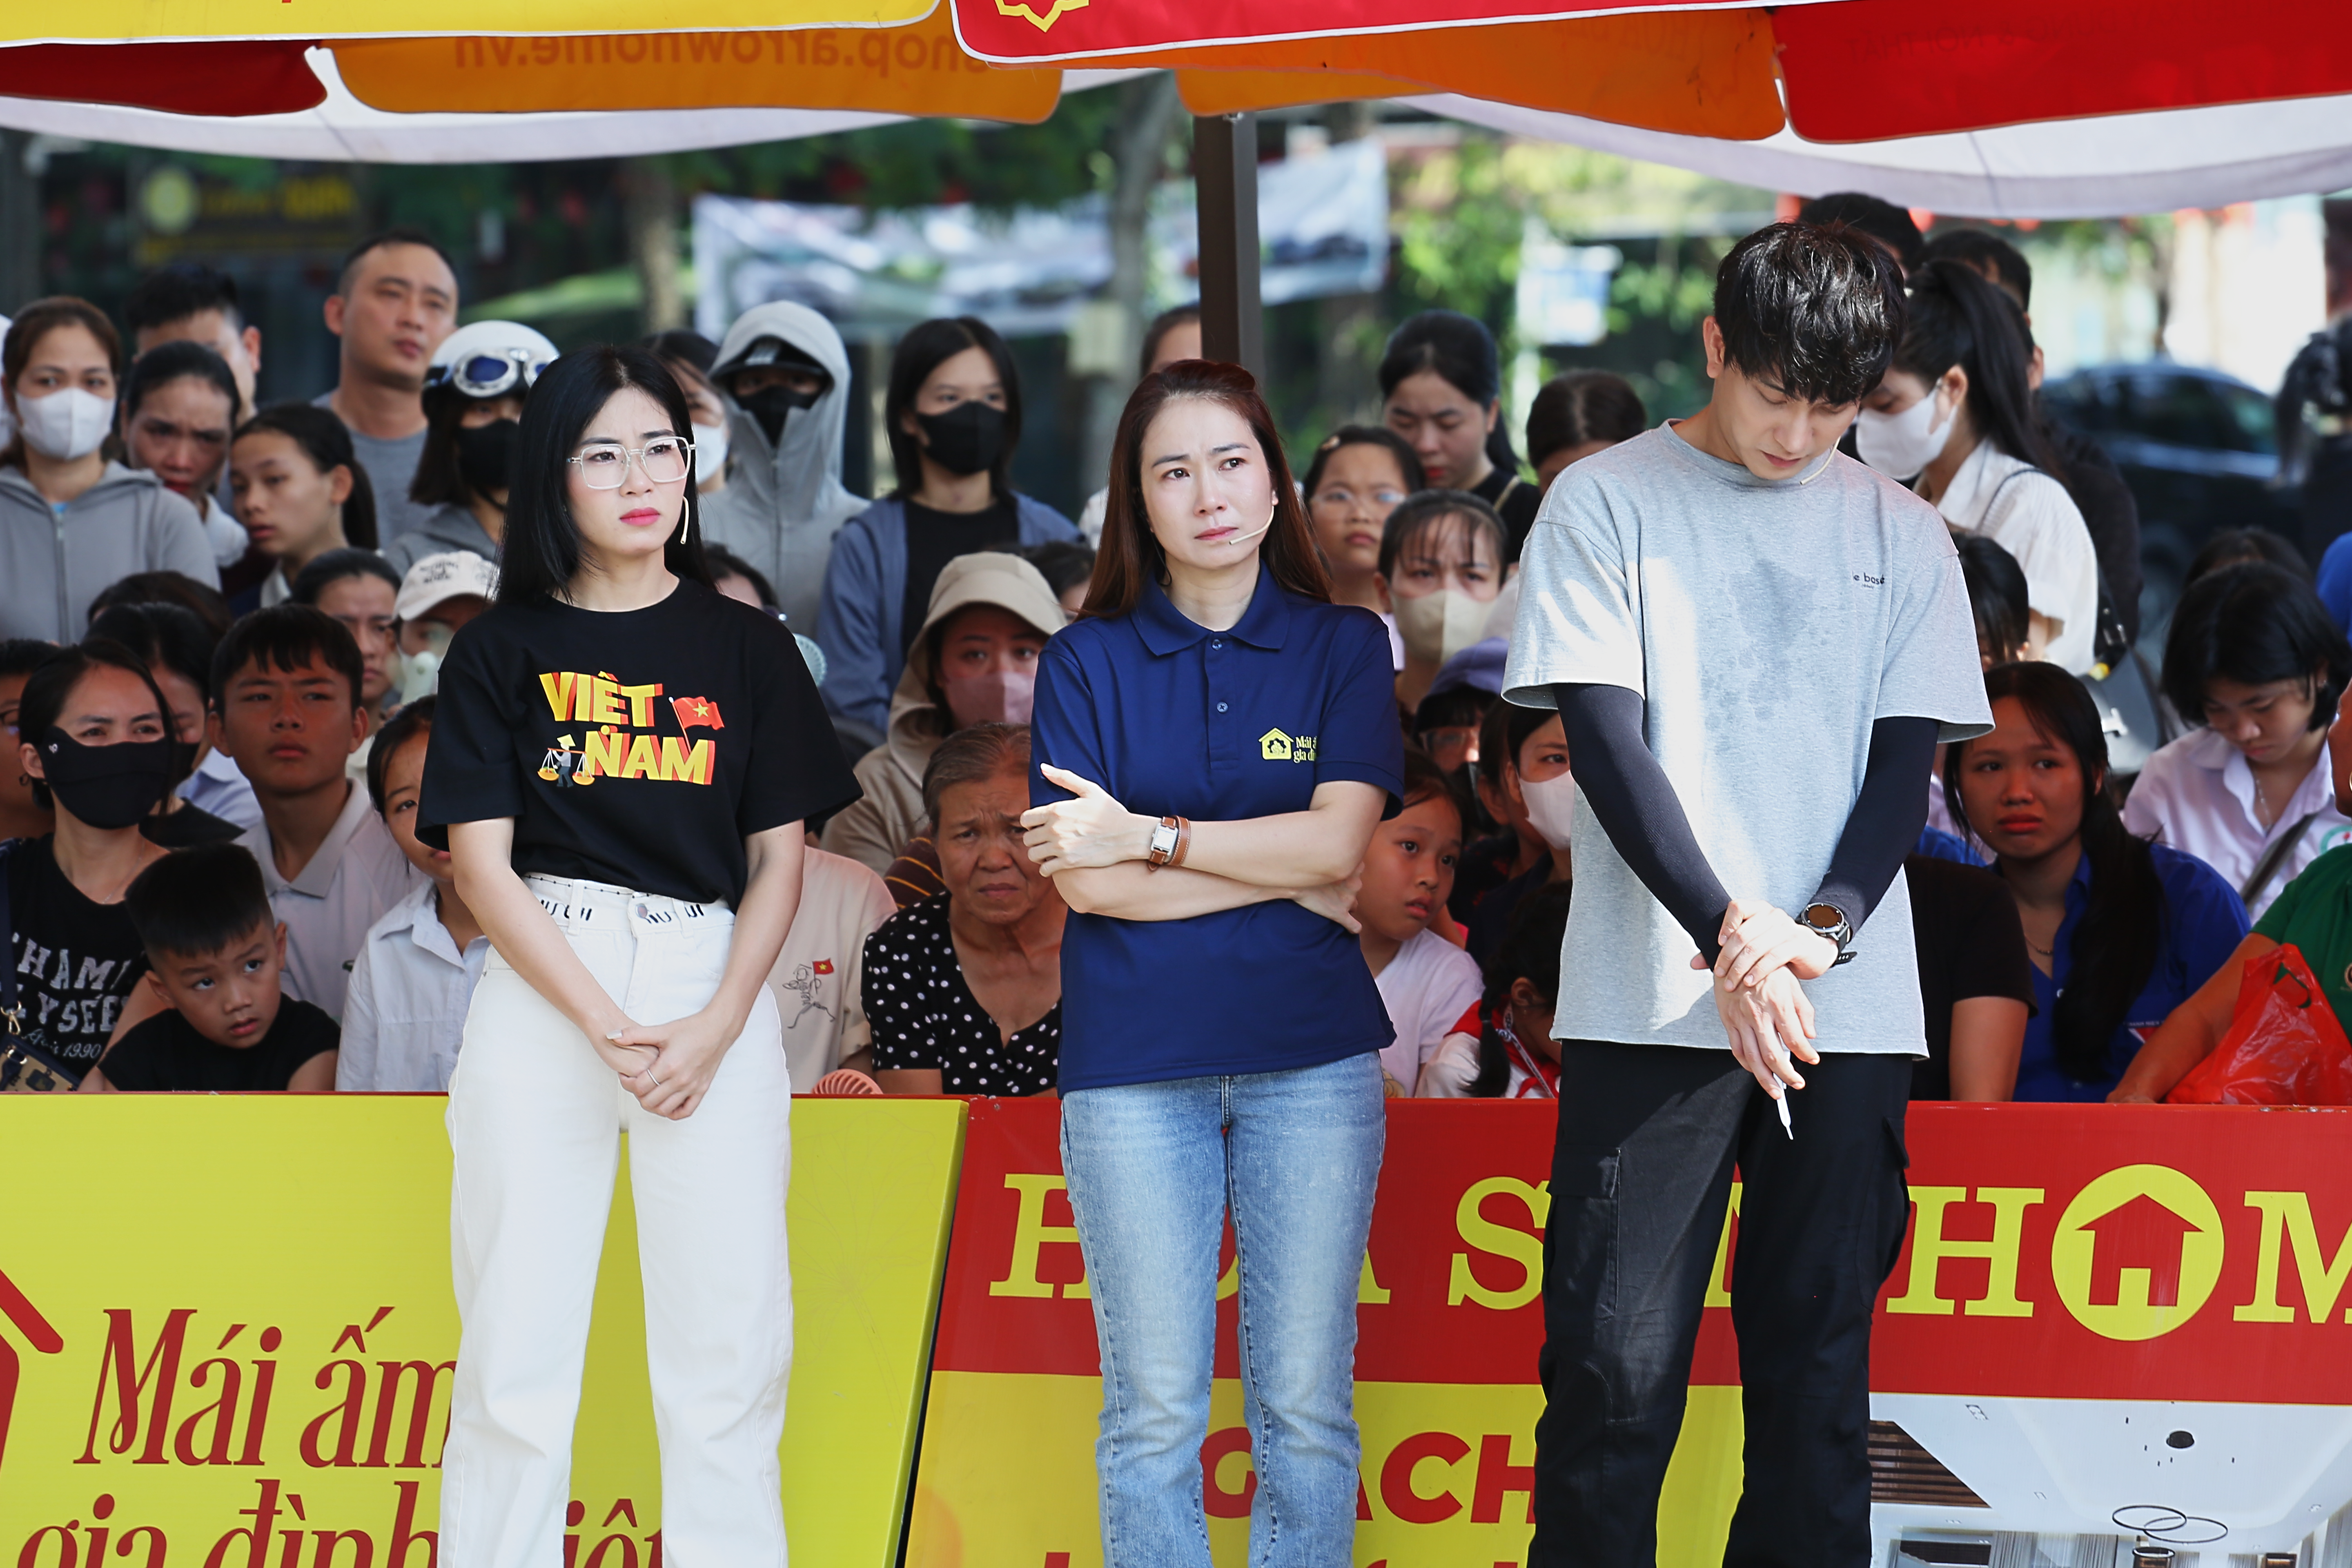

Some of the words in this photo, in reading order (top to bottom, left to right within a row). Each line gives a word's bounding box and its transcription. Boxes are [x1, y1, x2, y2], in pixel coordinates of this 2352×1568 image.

[539, 671, 663, 735] VIỆT
[584, 731, 715, 785] NAM
[1294, 748, 1307, 763] gia
[63, 1042, 101, 1058] 1990
[74, 1309, 283, 1466] Mái
[299, 1306, 457, 1468] ấm
[1200, 1426, 1537, 1524] GCH
